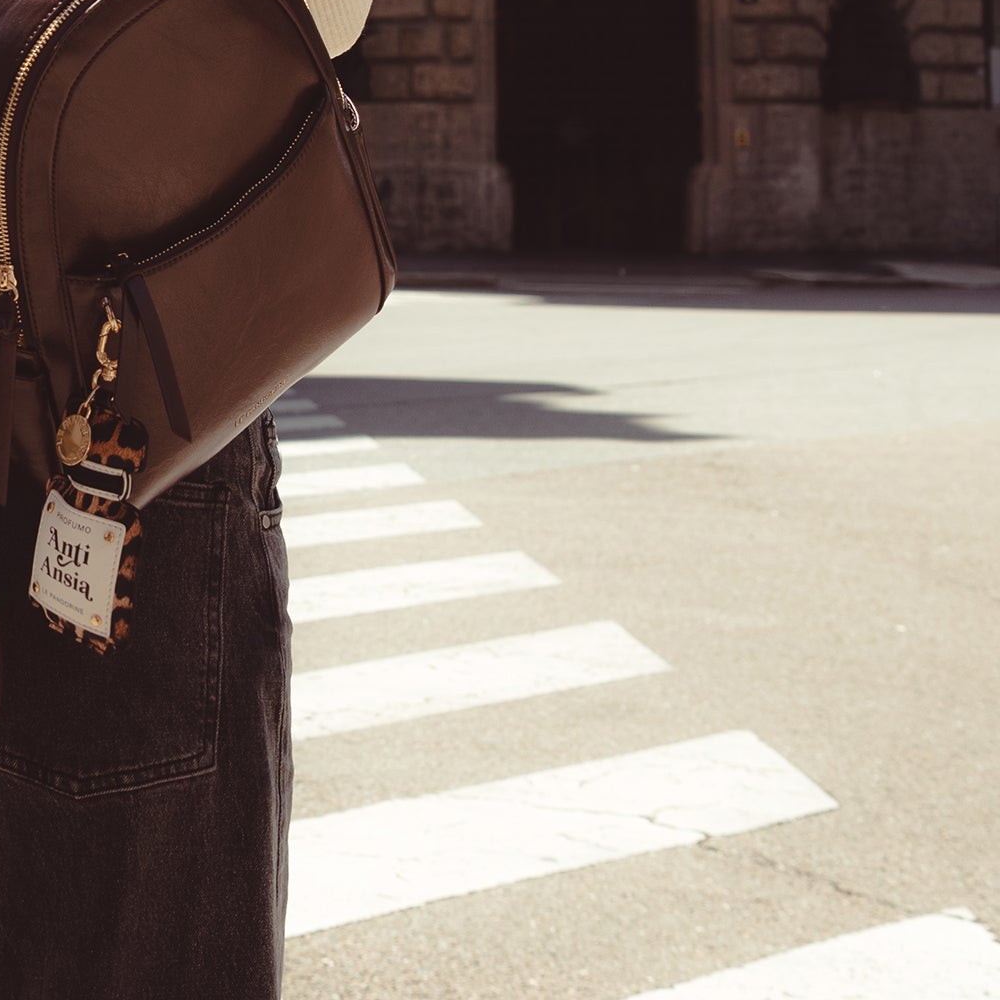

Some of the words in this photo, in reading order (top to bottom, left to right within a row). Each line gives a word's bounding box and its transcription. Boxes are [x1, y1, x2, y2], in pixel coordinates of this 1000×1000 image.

[56, 511, 92, 534] PROFUMO
[47, 526, 90, 567] Anti
[40, 556, 93, 601] Ansia
